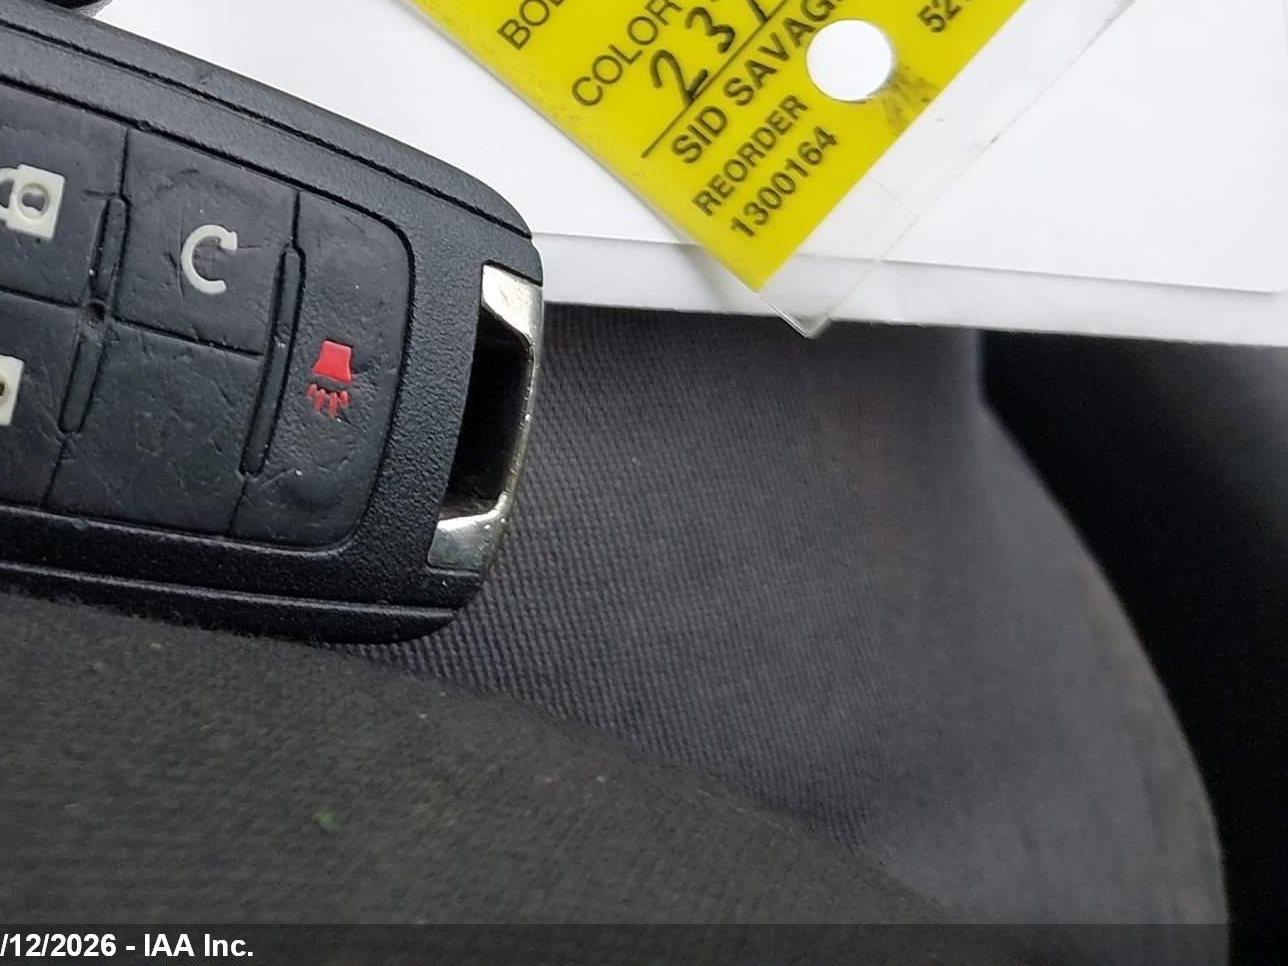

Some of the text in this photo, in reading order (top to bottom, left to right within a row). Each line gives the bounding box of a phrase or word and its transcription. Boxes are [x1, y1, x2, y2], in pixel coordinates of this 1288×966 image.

[670, 105, 729, 165] SID
[691, 93, 809, 217] REORDER
[730, 126, 839, 237] 1300164
